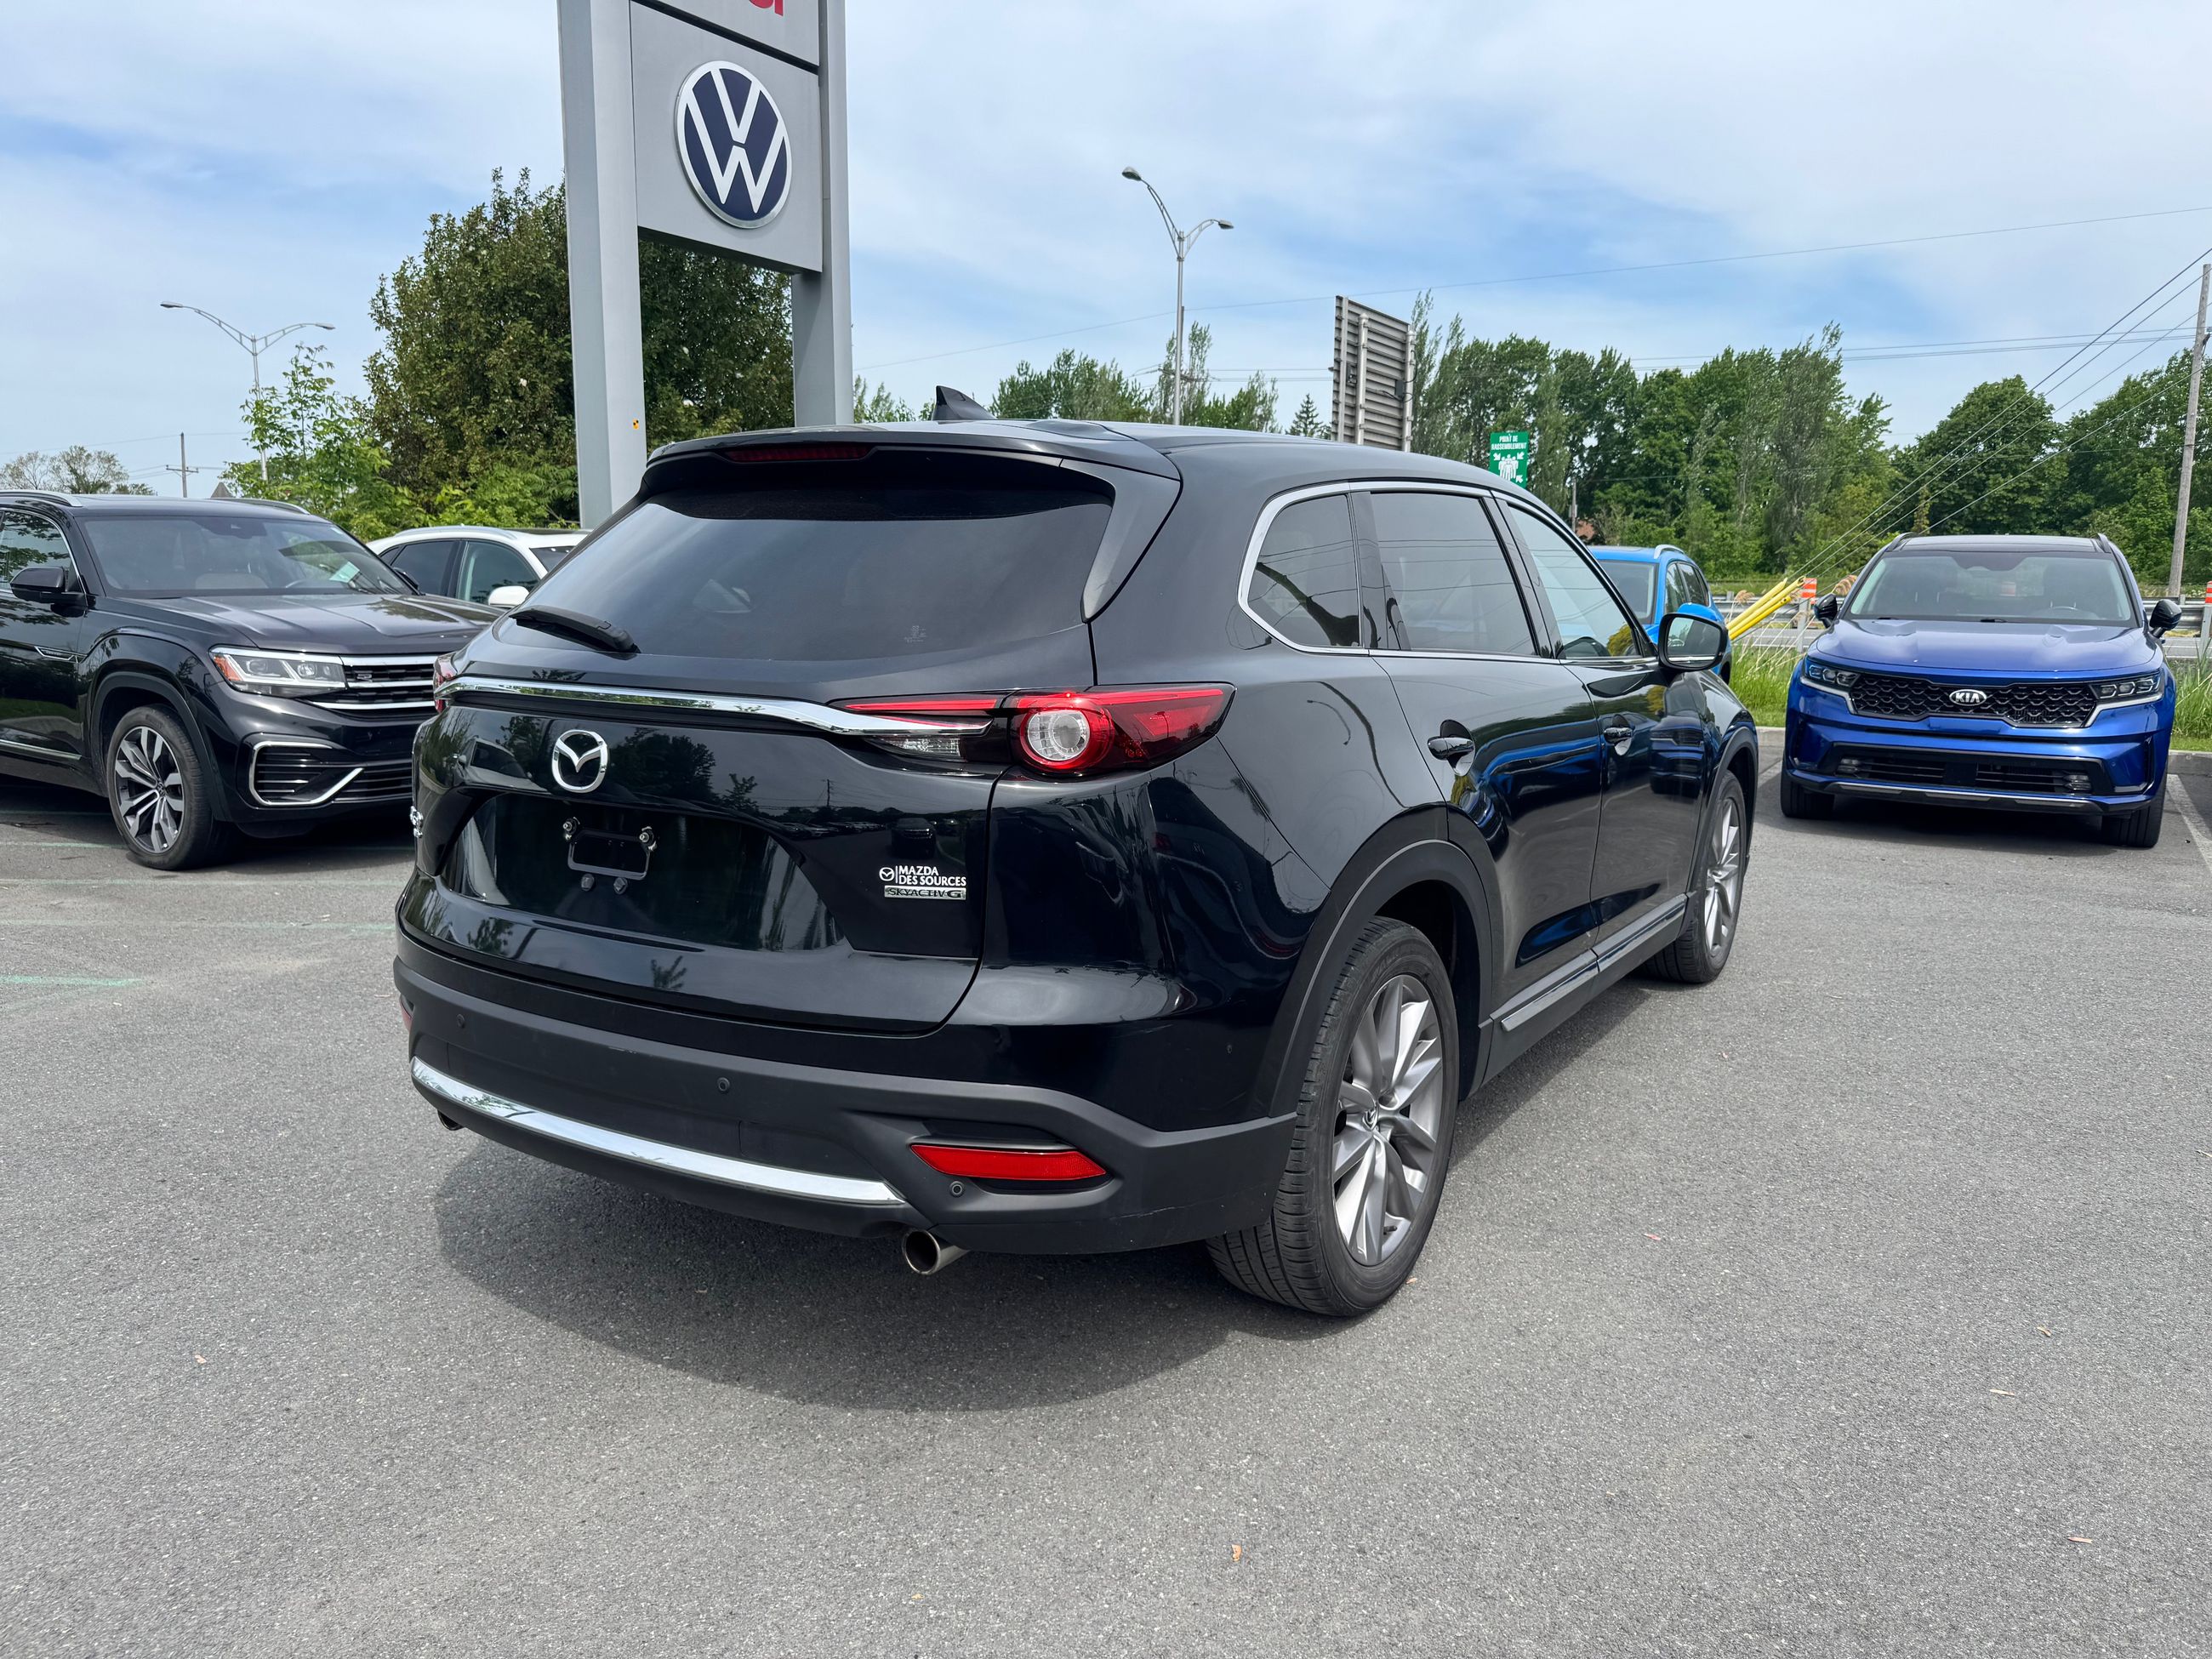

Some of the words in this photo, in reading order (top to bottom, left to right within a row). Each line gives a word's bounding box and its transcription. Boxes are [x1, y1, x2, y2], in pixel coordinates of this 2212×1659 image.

[680, 65, 790, 214] VW
[1955, 692, 1980, 703] KIA
[898, 865, 938, 875] MAZDA
[898, 875, 918, 885] DES
[920, 876, 966, 887] SOURCES
